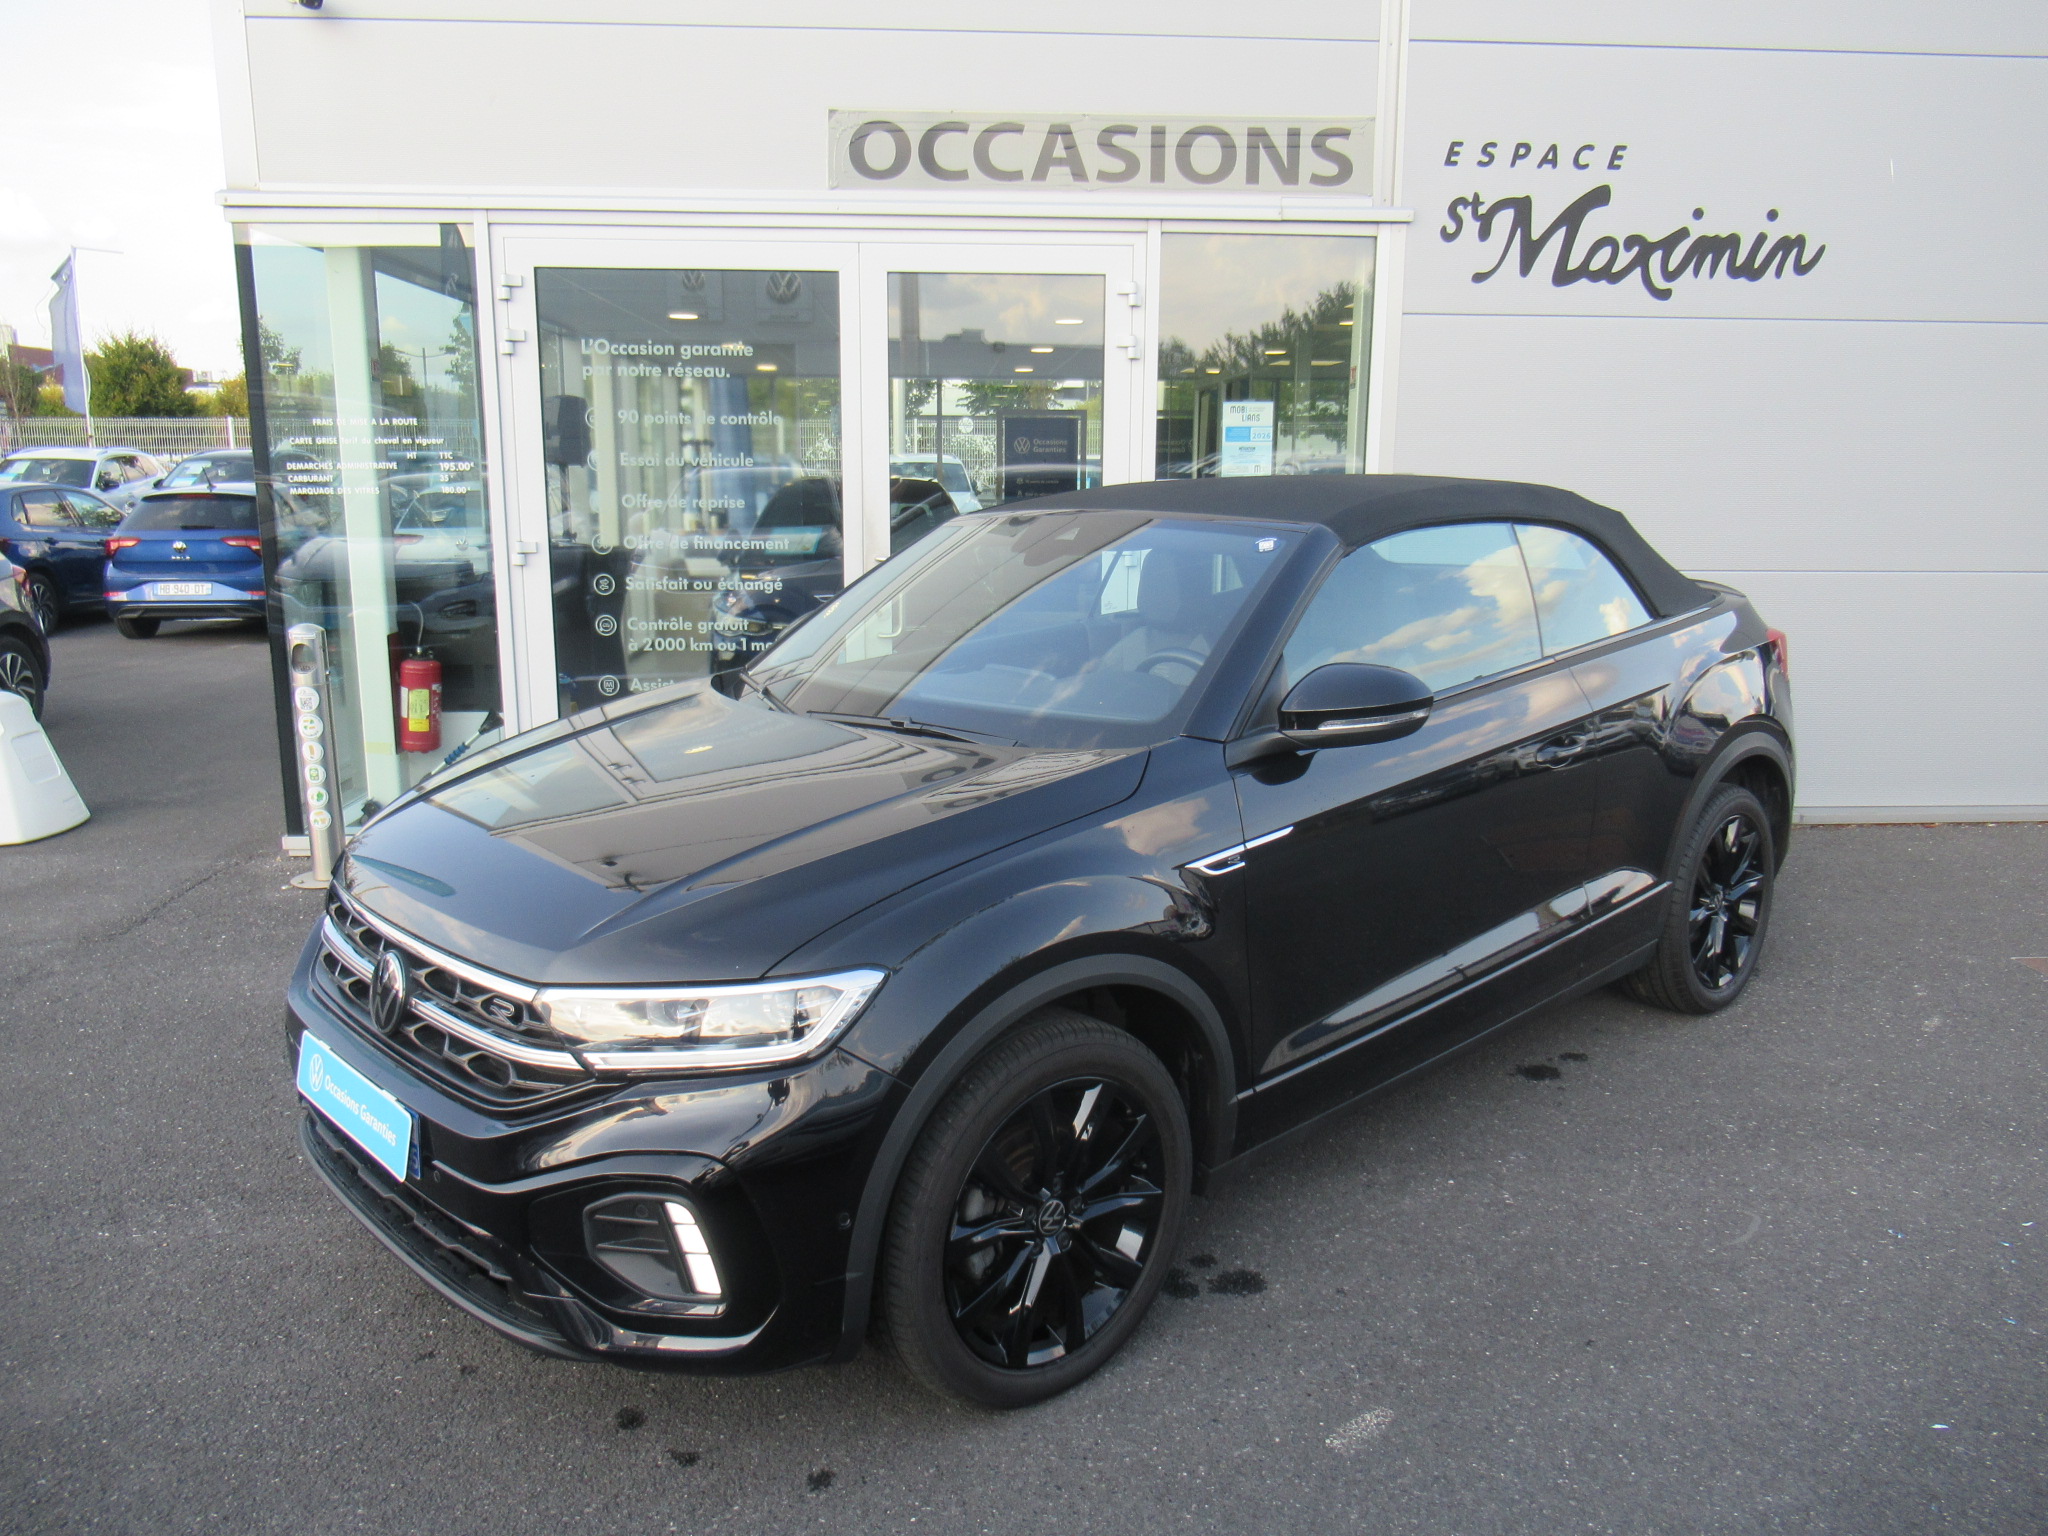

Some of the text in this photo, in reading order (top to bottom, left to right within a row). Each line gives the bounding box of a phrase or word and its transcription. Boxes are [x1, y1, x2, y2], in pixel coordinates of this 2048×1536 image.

[848, 120, 1354, 188] OCCASIONS
[1443, 140, 1628, 171] ESPACE
[1439, 184, 1827, 301] St Maximin
[580, 338, 754, 360] L'Occasion garantie
[582, 361, 731, 380] par notre réseau.
[312, 417, 334, 427] FRAIS
[371, 417, 378, 426] A
[379, 417, 390, 426] LA
[392, 417, 418, 426] ROUTE
[617, 409, 640, 425] 90
[644, 410, 692, 428] points
[720, 410, 784, 426] contrôle
[289, 437, 313, 445] CARTE
[315, 437, 338, 445] GRISE
[374, 435, 400, 445] cheval
[415, 435, 445, 447] vigueur
[406, 451, 454, 460] HT TTC
[619, 451, 754, 467] Essai du véhicule
[286, 461, 334, 471] DEMARCHES
[287, 475, 334, 483] CARBURANT
[289, 486, 335, 495] MARQUAGE
[621, 493, 746, 512] Offre de reprise
[623, 534, 664, 550] Offre
[694, 534, 790, 550] financement
[625, 575, 783, 594] Satisfait ou échangé
[627, 616, 750, 634] Contrôle gratuit
[628, 638, 639, 652] à
[690, 637, 714, 651] km
[717, 640, 738, 652] ou
[740, 637, 748, 652] 1
[324, 1075, 360, 1115] Occasions
[360, 1104, 397, 1147] Garanties
